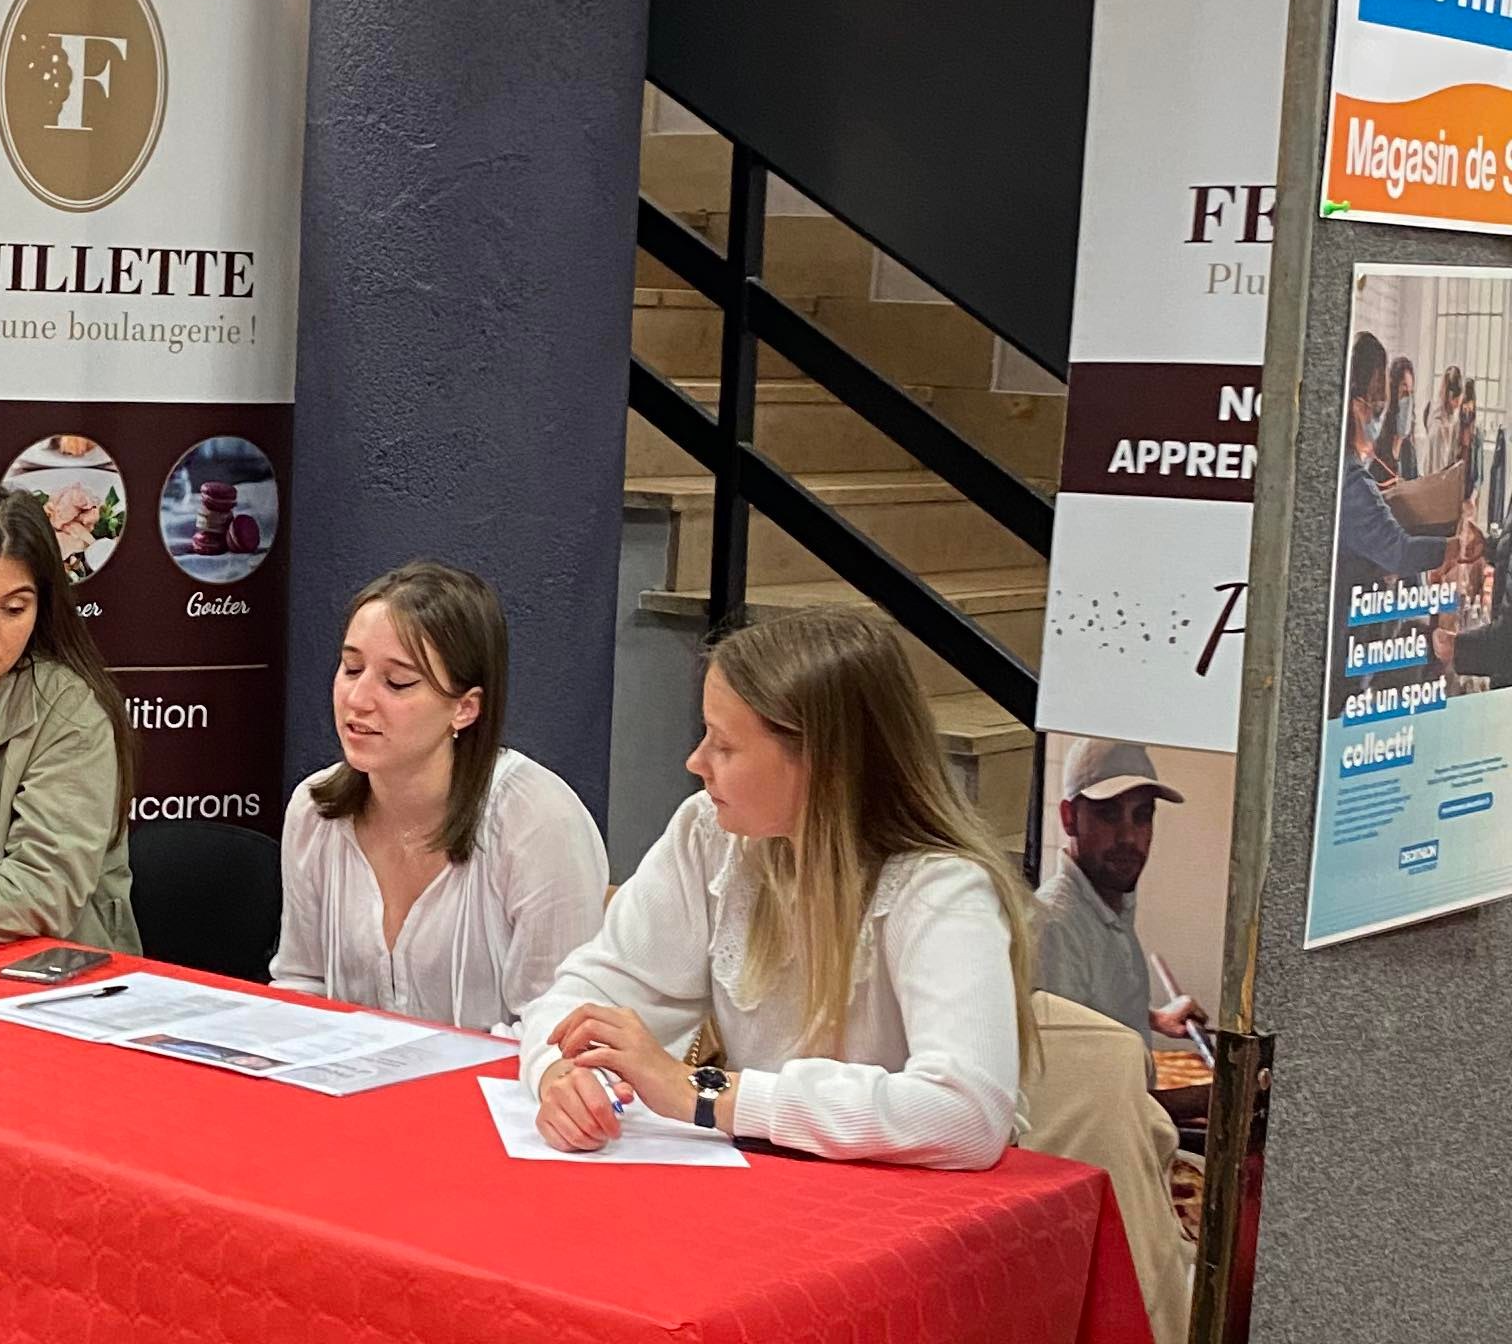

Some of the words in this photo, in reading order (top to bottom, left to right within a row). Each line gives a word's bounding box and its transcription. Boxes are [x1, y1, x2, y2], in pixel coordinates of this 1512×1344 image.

[1345, 116, 1458, 199] Magasin
[1465, 135, 1496, 192] de
[67, 310, 241, 354] boulangerie
[186, 591, 251, 618] Goûter
[1350, 583, 1393, 617] Faire
[1398, 580, 1456, 615] bouger
[1347, 636, 1363, 668] le
[1368, 627, 1427, 665] monde
[1345, 687, 1373, 718] est
[1377, 686, 1398, 711] un
[1401, 675, 1448, 715] sport
[1342, 724, 1415, 769] collectif
